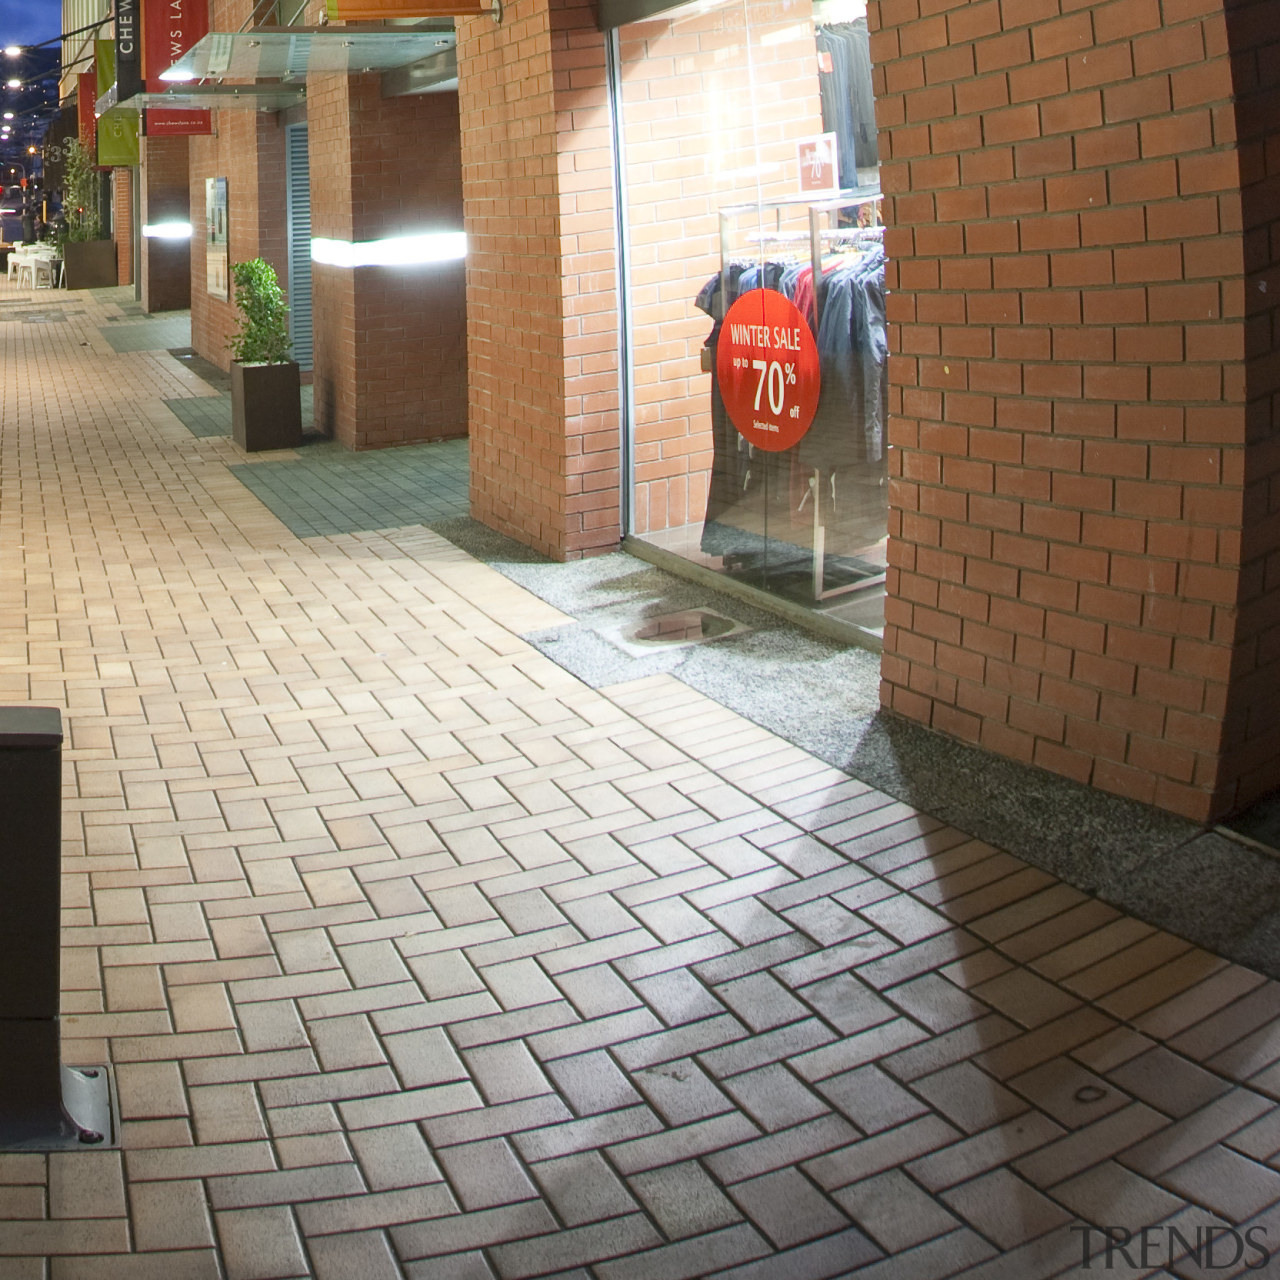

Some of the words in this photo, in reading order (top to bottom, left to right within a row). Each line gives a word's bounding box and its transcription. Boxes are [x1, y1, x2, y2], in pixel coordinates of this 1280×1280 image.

[730, 323, 771, 349] WINTER
[773, 326, 801, 351] SALE
[732, 357, 741, 369] up
[742, 357, 749, 368] to
[789, 406, 800, 419] off
